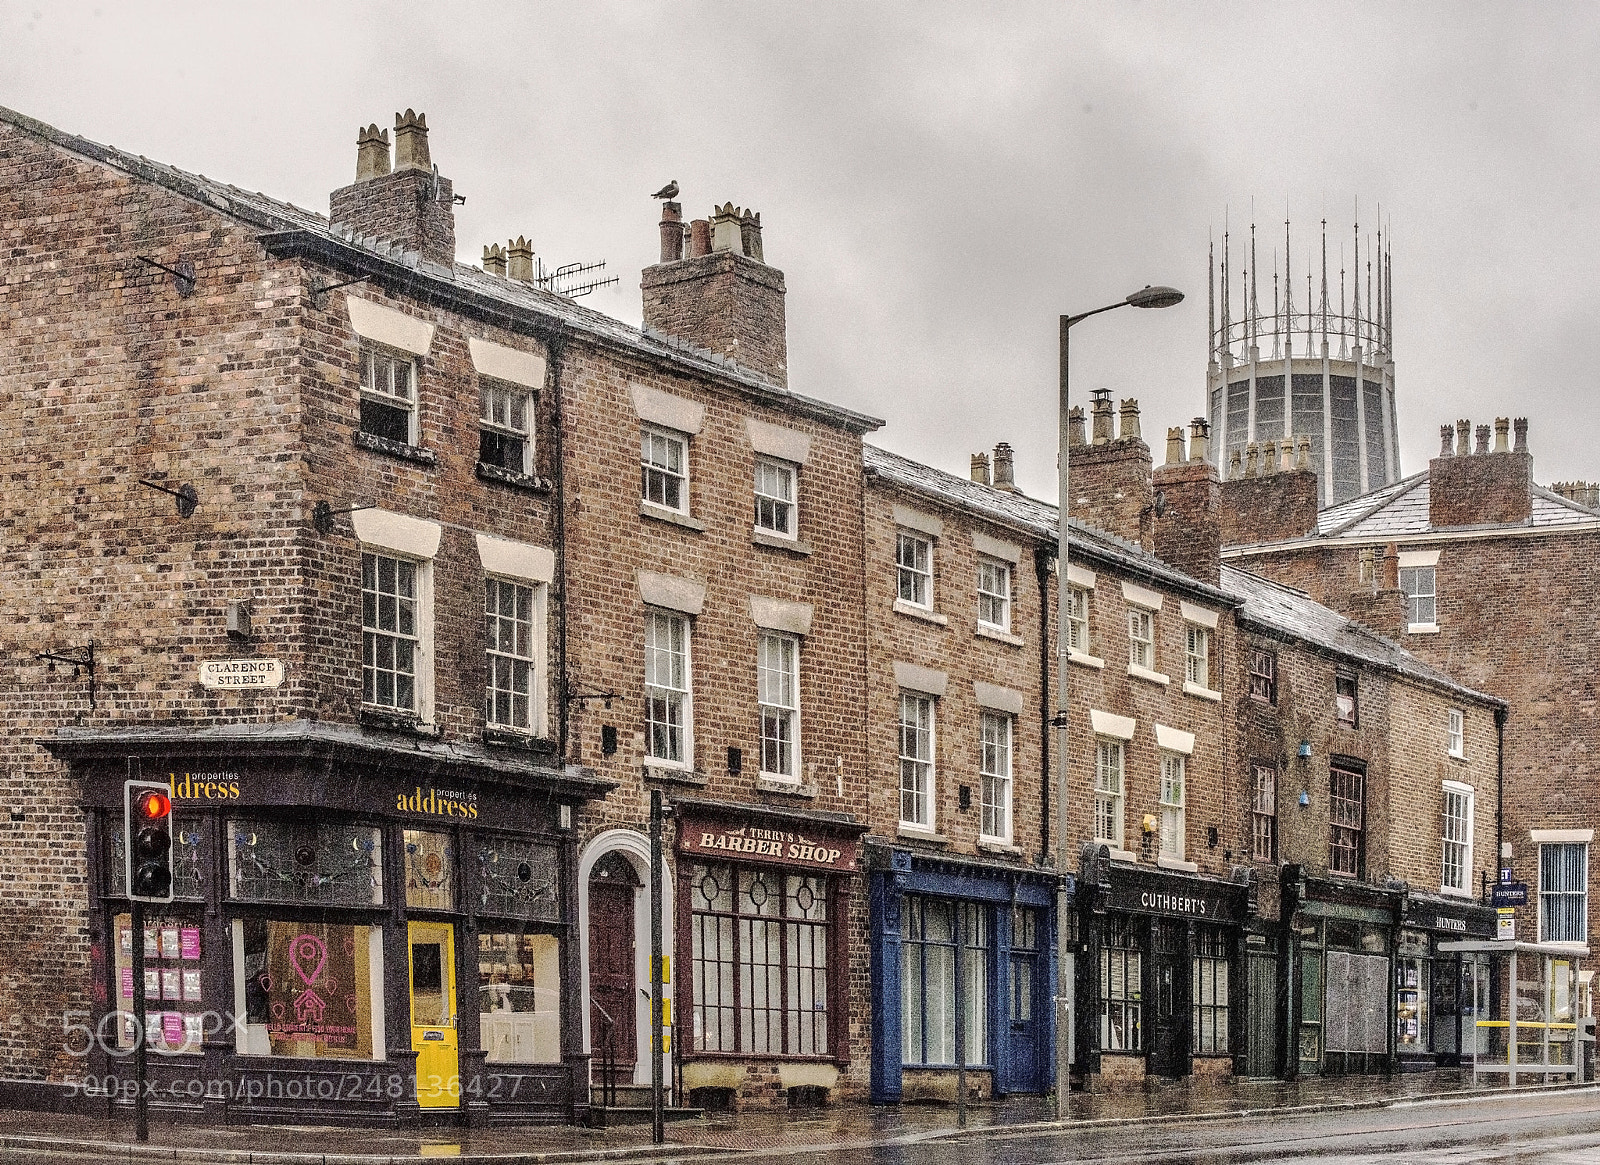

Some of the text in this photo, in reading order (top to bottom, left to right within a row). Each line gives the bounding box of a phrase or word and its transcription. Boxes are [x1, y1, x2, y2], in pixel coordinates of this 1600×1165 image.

[207, 662, 275, 673] CLARENCE
[217, 674, 266, 685] STREET
[191, 771, 240, 782] properties
[169, 772, 240, 799] dress
[396, 786, 478, 820] address
[749, 827, 794, 843] TERRY'S
[699, 832, 841, 863] BARBER SHOP
[1141, 892, 1206, 914] CUTHBERT'S
[1435, 916, 1466, 931] HUNTERS
